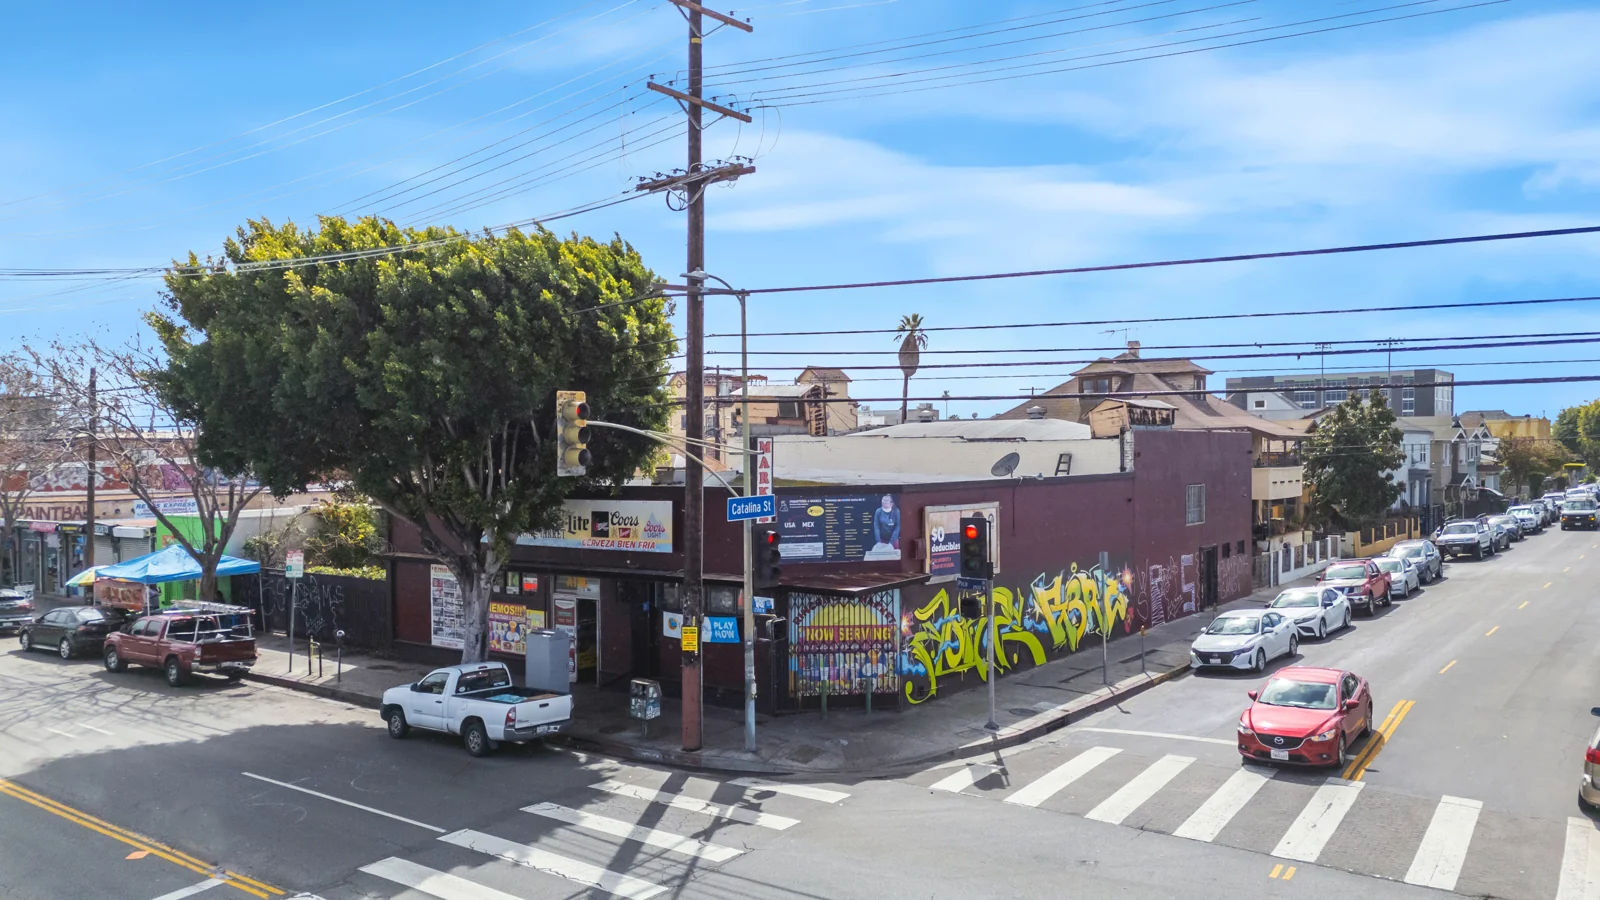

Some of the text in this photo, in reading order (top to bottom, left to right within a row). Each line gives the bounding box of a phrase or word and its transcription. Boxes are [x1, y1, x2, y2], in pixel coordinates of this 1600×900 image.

[759, 441, 771, 522] MARK
[163, 501, 197, 509] EXPRESS
[732, 500, 772, 515] Catalina St
[567, 515, 589, 534] Lite
[610, 511, 640, 526] Coors
[643, 520, 666, 533] Coors
[932, 526, 945, 542] $0
[581, 539, 656, 549] CERVEZA BIEN FRIA
[932, 542, 960, 552] deducibles
[713, 621, 734, 630] PLAY
[714, 630, 735, 639] NOW
[805, 627, 891, 641] NOW SERVNG
